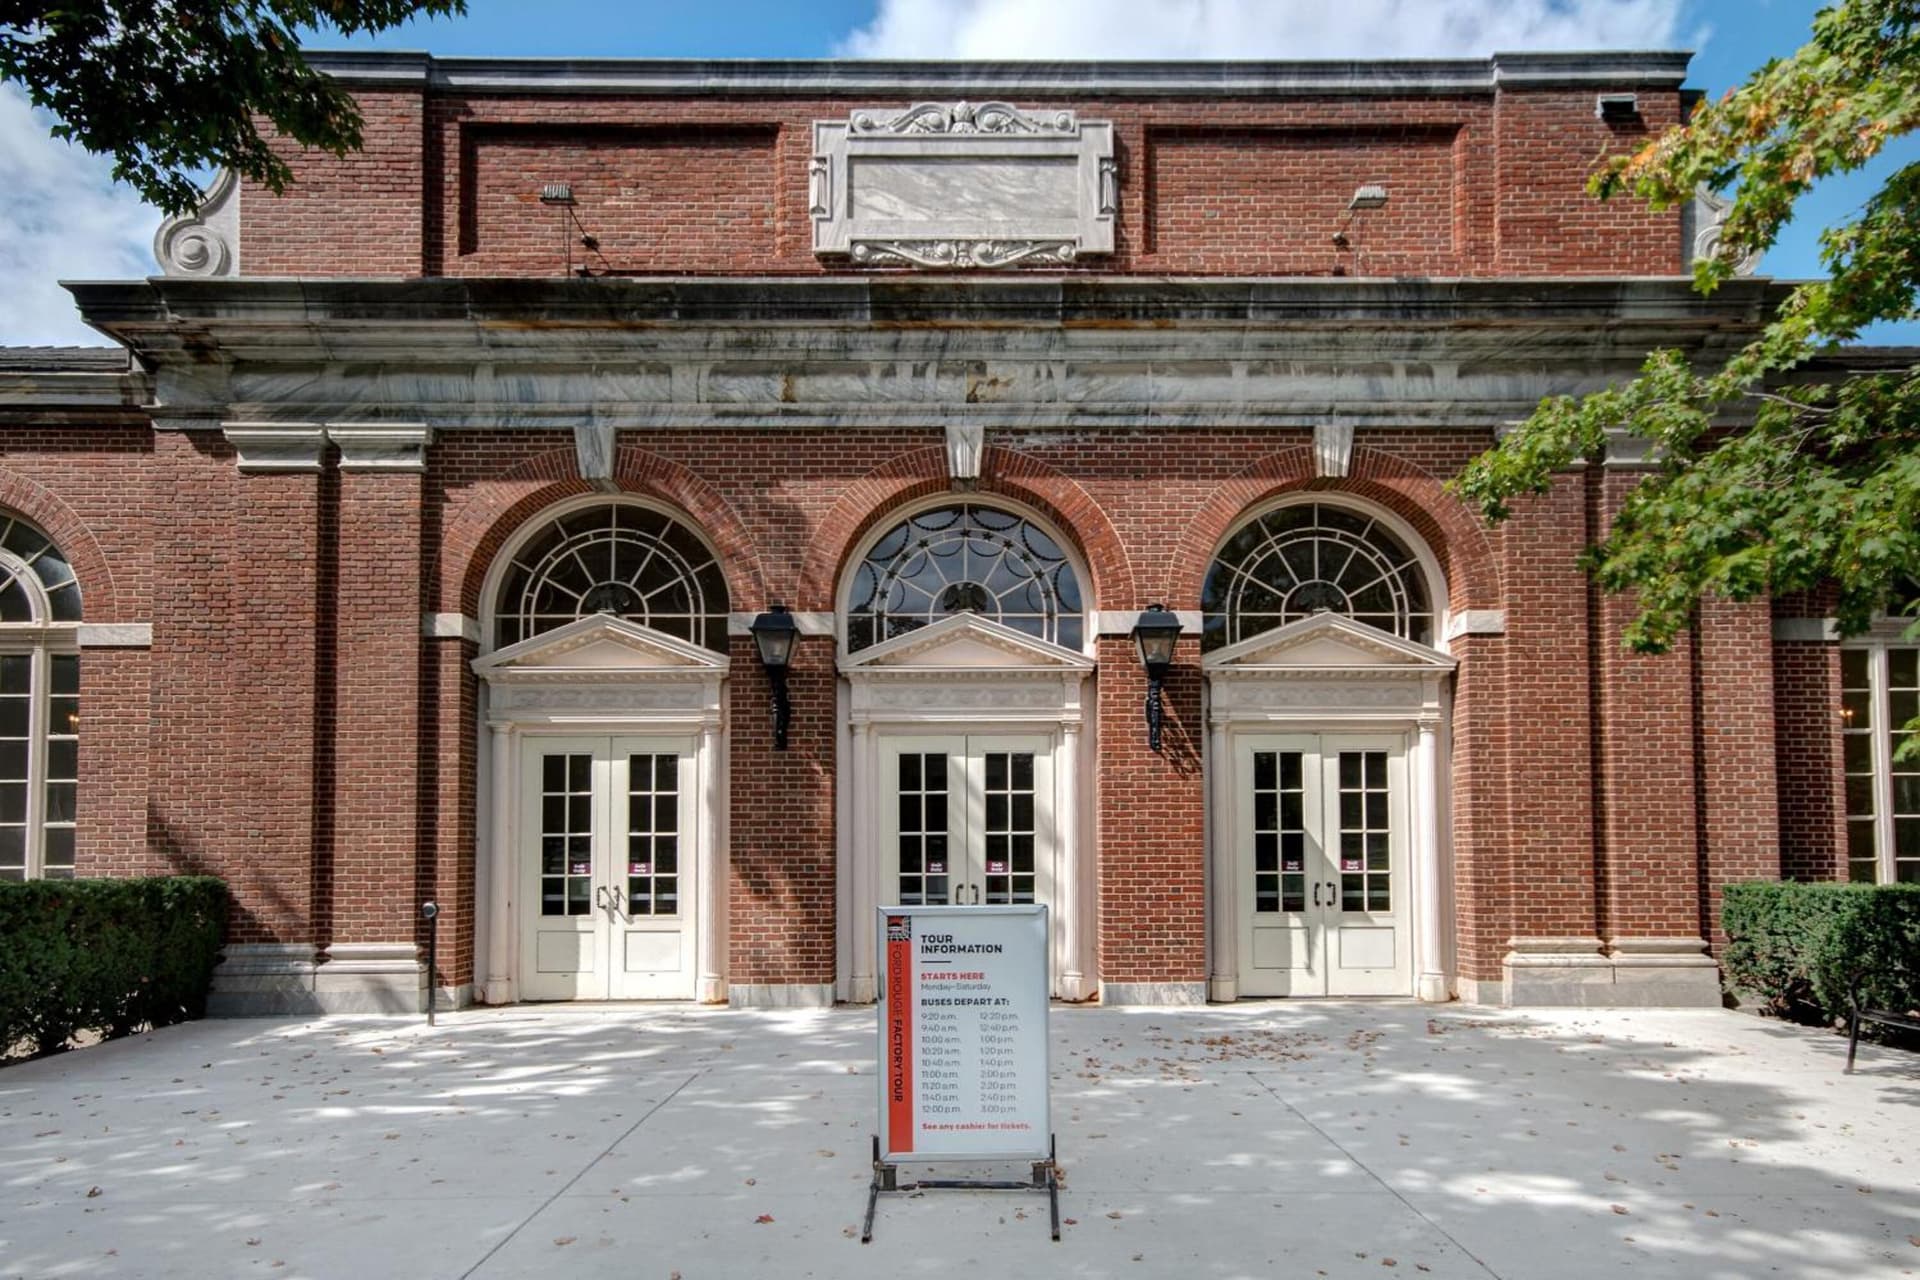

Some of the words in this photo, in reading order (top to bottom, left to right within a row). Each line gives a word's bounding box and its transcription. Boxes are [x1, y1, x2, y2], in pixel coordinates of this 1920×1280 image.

[921, 934, 953, 944] TOUR
[921, 944, 1002, 954] INFORMATION
[893, 944, 902, 973] FORD
[921, 972, 958, 980] STARTS
[960, 972, 984, 980] HERE
[921, 998, 952, 1006] BUSES
[954, 998, 992, 1006] DEPART
[994, 998, 1010, 1006] AT:
[894, 1019, 903, 1070] FACTORY
[894, 1072, 903, 1102] TOUR
[956, 1122, 985, 1130] cashier
